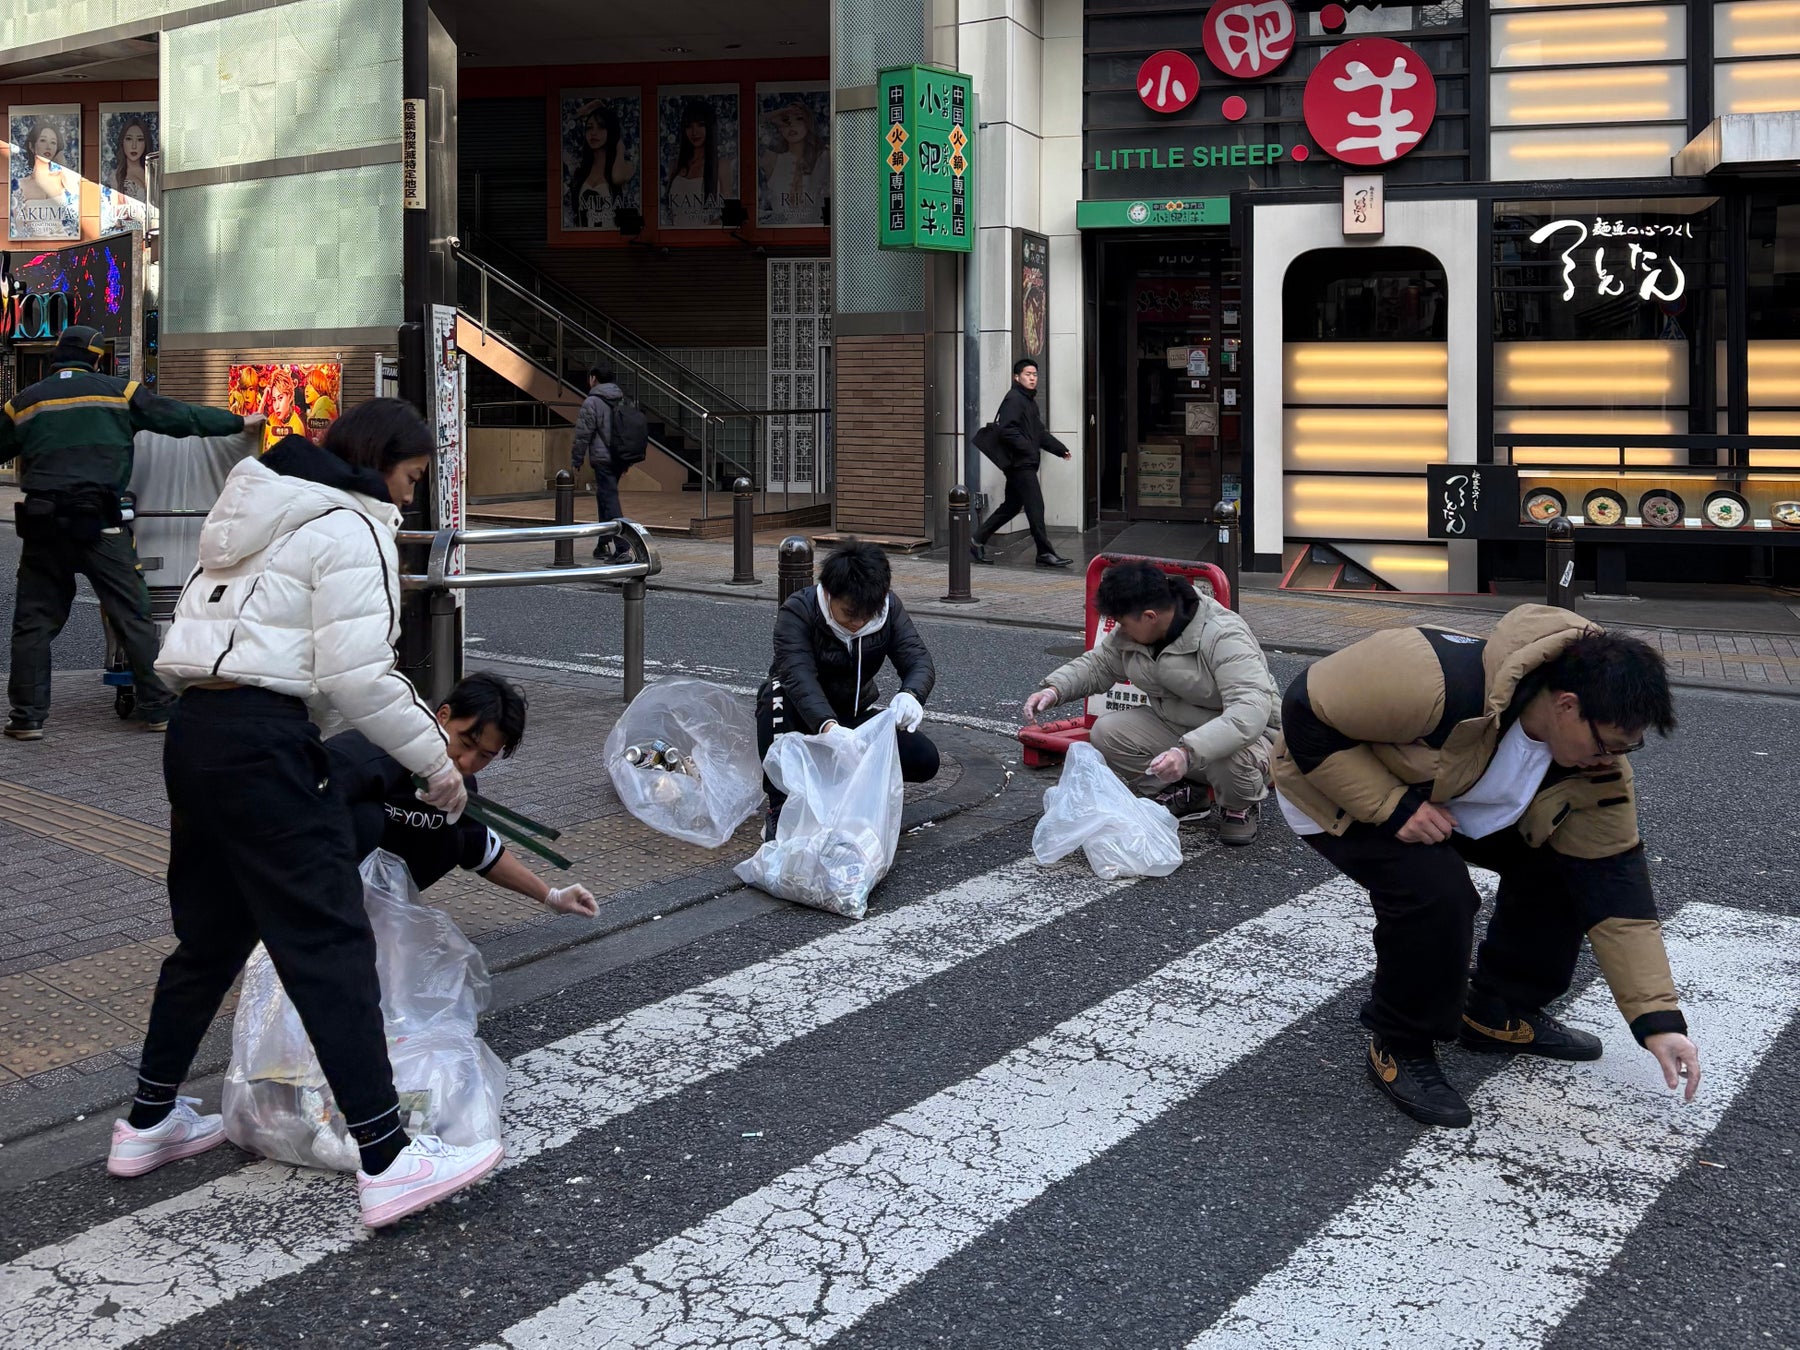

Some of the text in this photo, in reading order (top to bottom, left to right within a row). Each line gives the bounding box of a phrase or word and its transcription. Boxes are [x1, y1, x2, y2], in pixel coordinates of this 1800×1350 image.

[1140, 0, 1423, 160] 小 肥 羊
[942, 84, 950, 119] しゃお
[404, 102, 416, 198] 危険薬物撲滅特定地区
[890, 86, 904, 230] 中国火鍋専門店
[920, 83, 942, 235] 小肥羊
[952, 86, 965, 235] 中国火鍋専門店
[1095, 144, 1283, 171] LITTLE SHEEP
[17, 207, 72, 220] AKUMA
[780, 192, 815, 207] RIN
[940, 201, 949, 235] やん
[1529, 219, 1686, 301] つるとんたん
[1142, 461, 1175, 469] キャベツ
[1141, 482, 1174, 491] キャベツ
[384, 802, 444, 830] BEYOND
